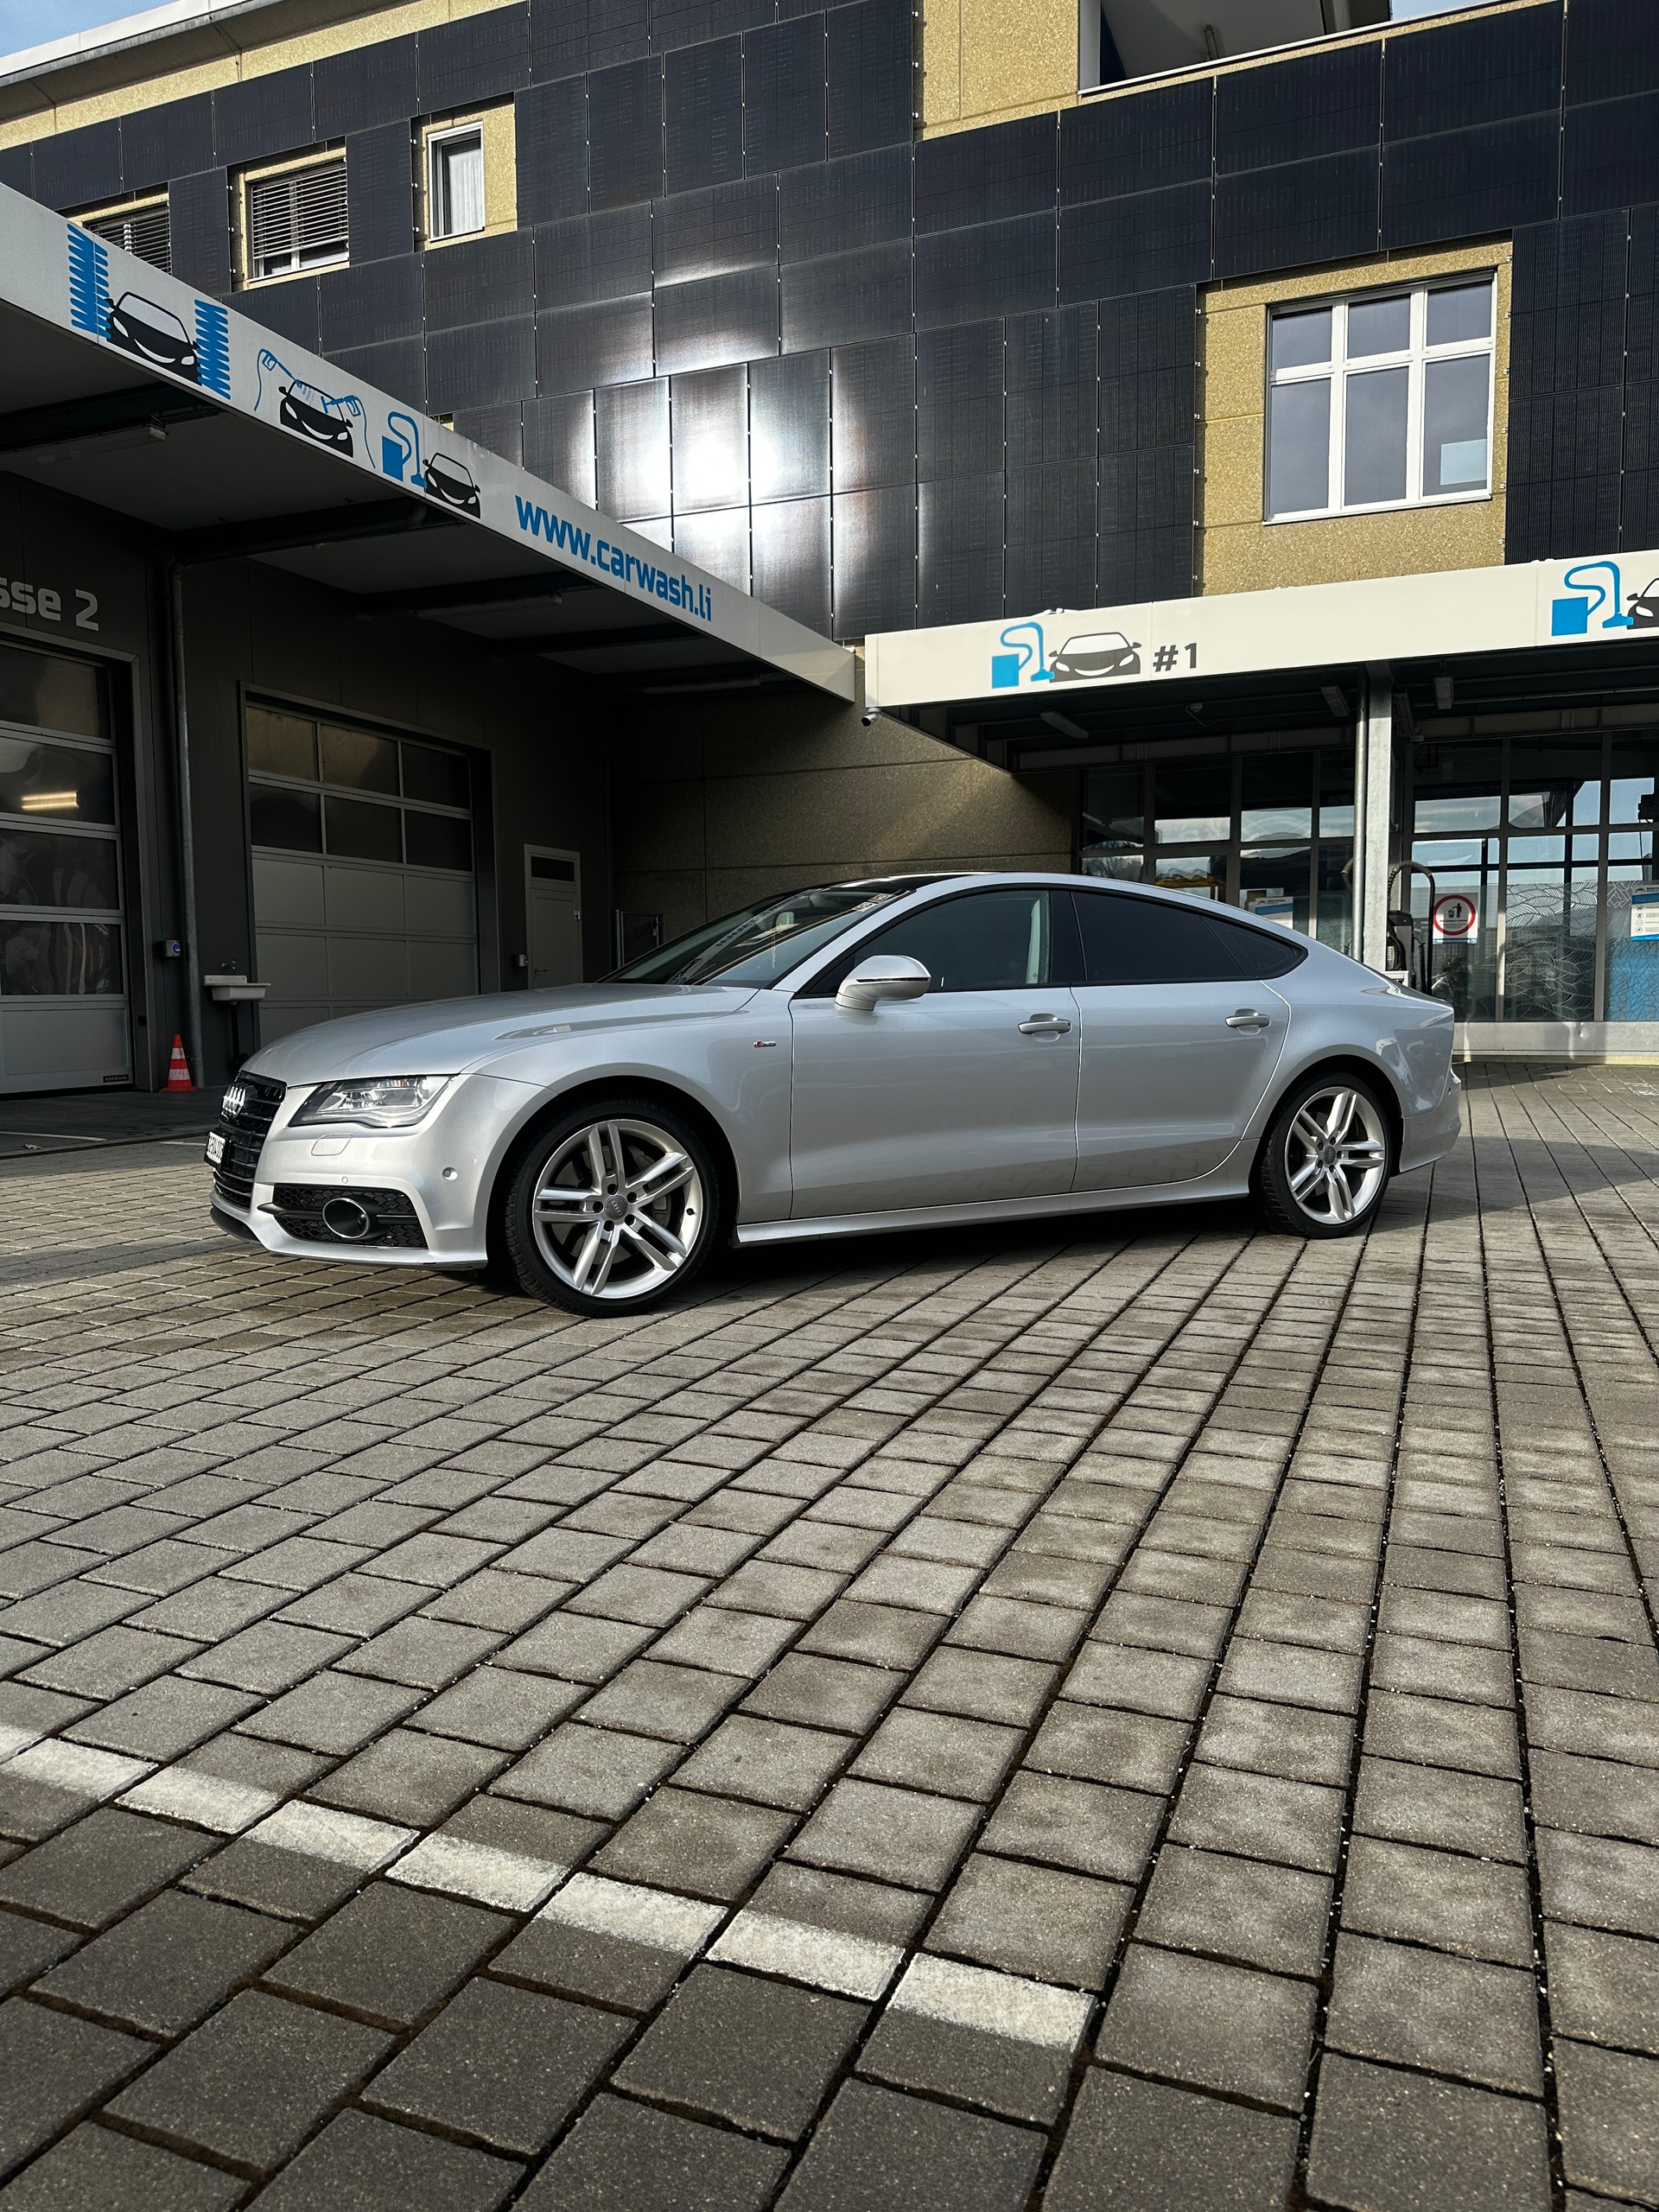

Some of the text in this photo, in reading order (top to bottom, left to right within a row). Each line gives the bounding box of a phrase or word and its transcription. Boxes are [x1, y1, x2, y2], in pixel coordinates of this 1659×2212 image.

[515, 495, 712, 622] www.carwash.li
[75, 588, 99, 632] 2
[1153, 642, 1197, 672] #1
